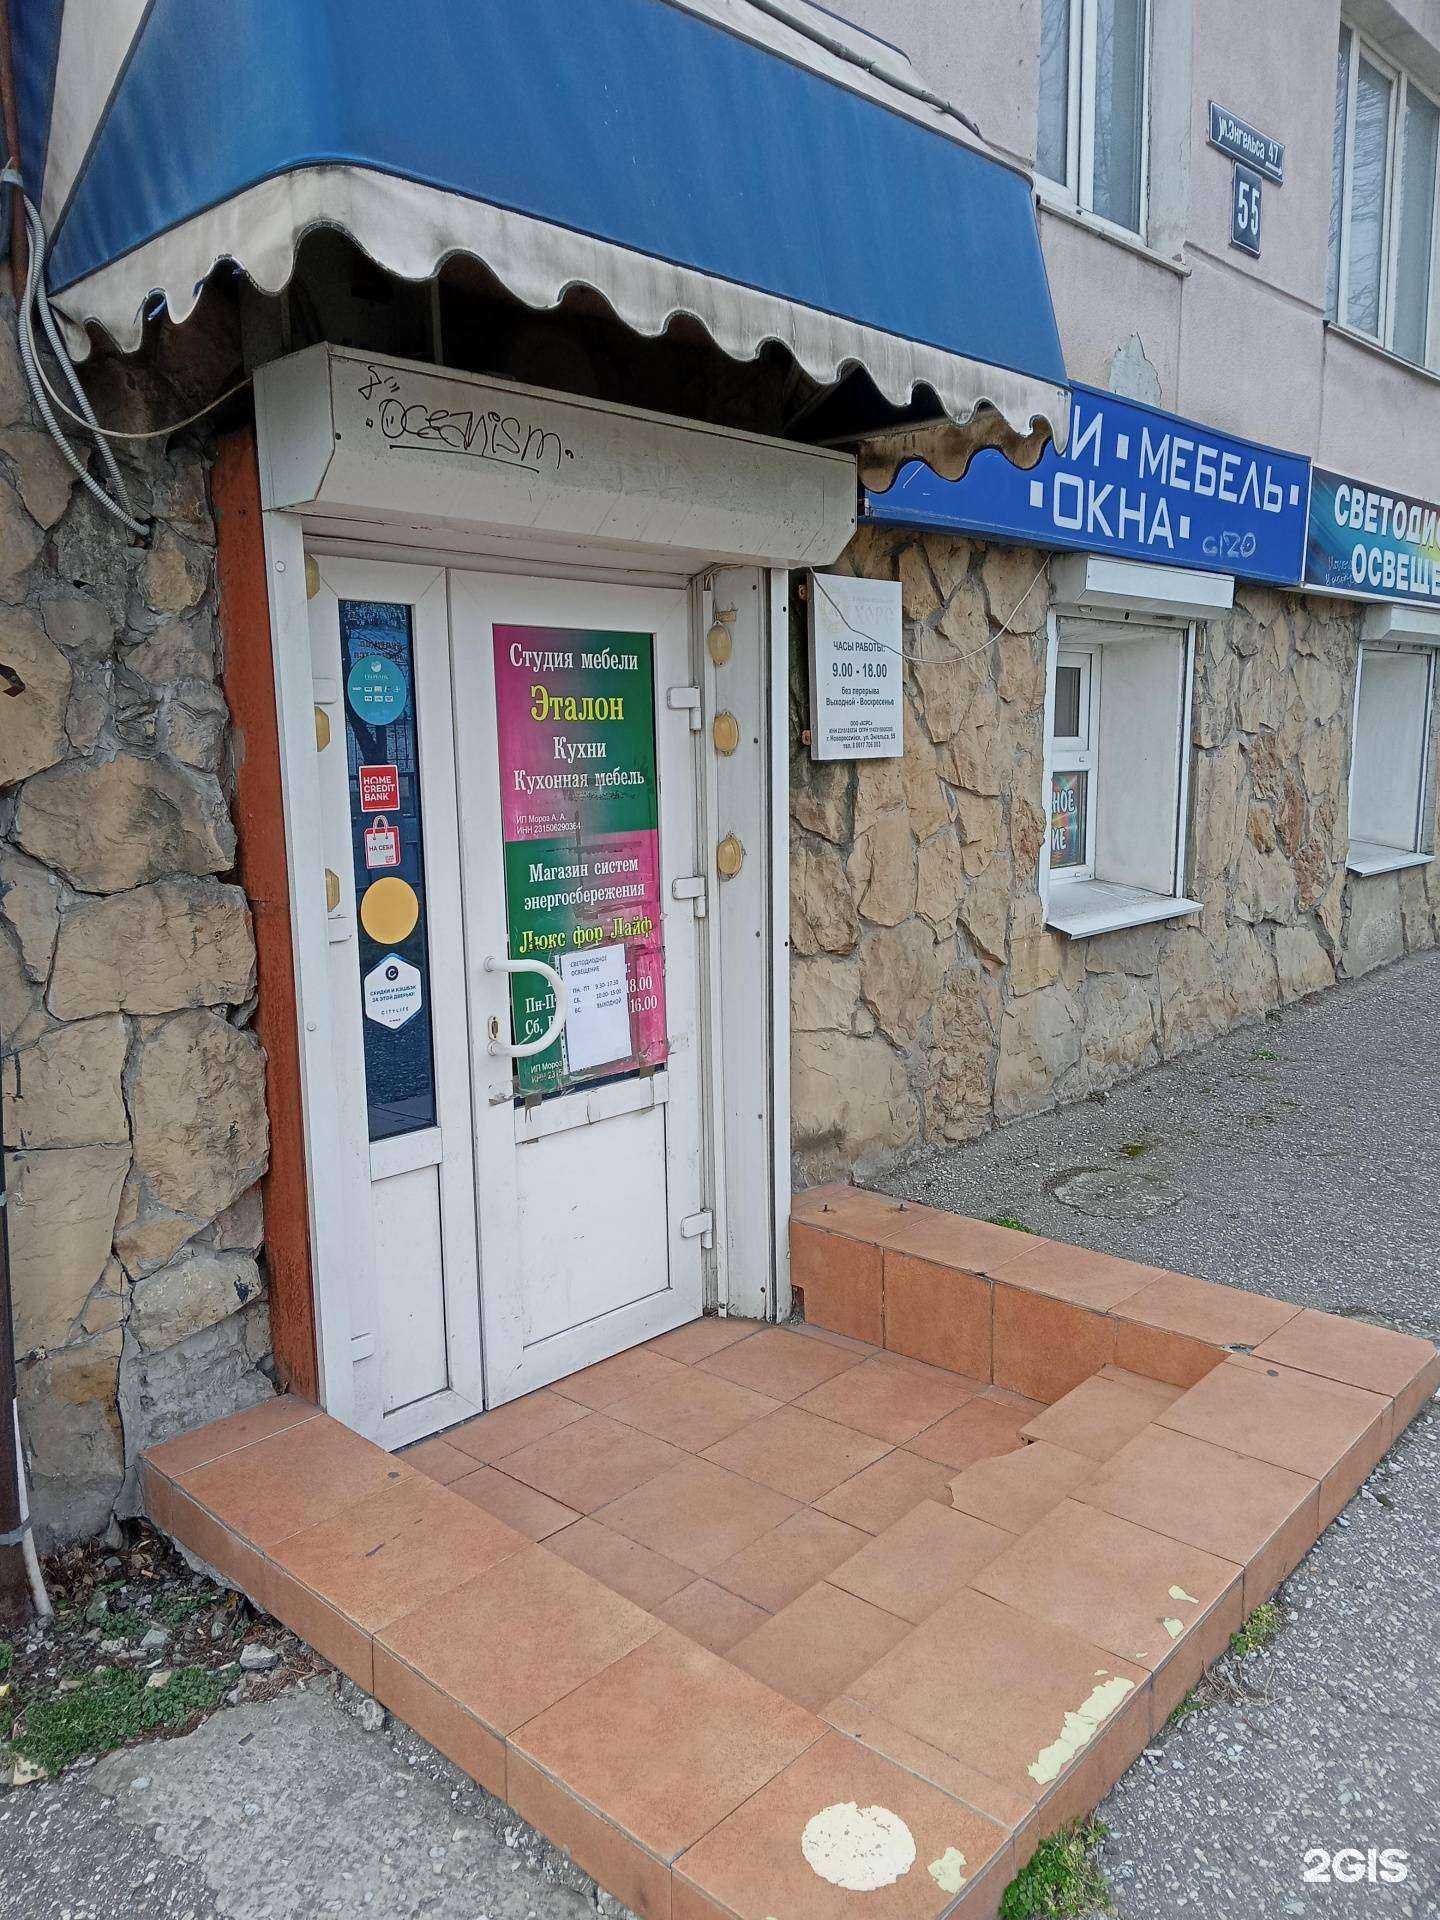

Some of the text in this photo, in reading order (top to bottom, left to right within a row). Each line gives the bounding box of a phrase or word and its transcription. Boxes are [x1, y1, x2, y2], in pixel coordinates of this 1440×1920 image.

[1268, 141, 1279, 163] 47
[1237, 181, 1261, 236] 55
[1064, 405, 1283, 514] И МЕБЕЛЬ
[1052, 471, 1175, 550] ОКНА
[1334, 483, 1440, 550] СВЕТОДИ
[1351, 543, 1440, 597] ОСВЕЩЕ
[833, 641, 854, 652] ЧАСЫ
[509, 642, 638, 673] Студия мебели
[832, 662, 853, 678] 9.00
[862, 663, 887, 678] 18.00
[826, 697, 855, 707] Выходной
[860, 697, 895, 707] Воскресенье
[841, 686, 880, 697] без перерыва
[530, 684, 625, 722] Эталон
[553, 736, 607, 764] Кухни
[363, 775, 392, 785] HOME
[363, 784, 396, 793] CREDIT
[513, 769, 589, 795] Кухонная
[595, 766, 645, 787] мебель
[364, 792, 390, 802] BANK
[516, 815, 527, 824] ИП
[528, 814, 550, 823] Мороз
[516, 825, 533, 835] ИНН
[528, 857, 639, 883] Магазин систем
[523, 882, 646, 912] энергосбережения
[519, 916, 653, 954] Люкс фор Лайф
[525, 993, 557, 1013] Пн-П
[630, 994, 658, 1013] 16.00
[525, 1018, 543, 1035] Сб,
[530, 1063, 541, 1074] ИП
